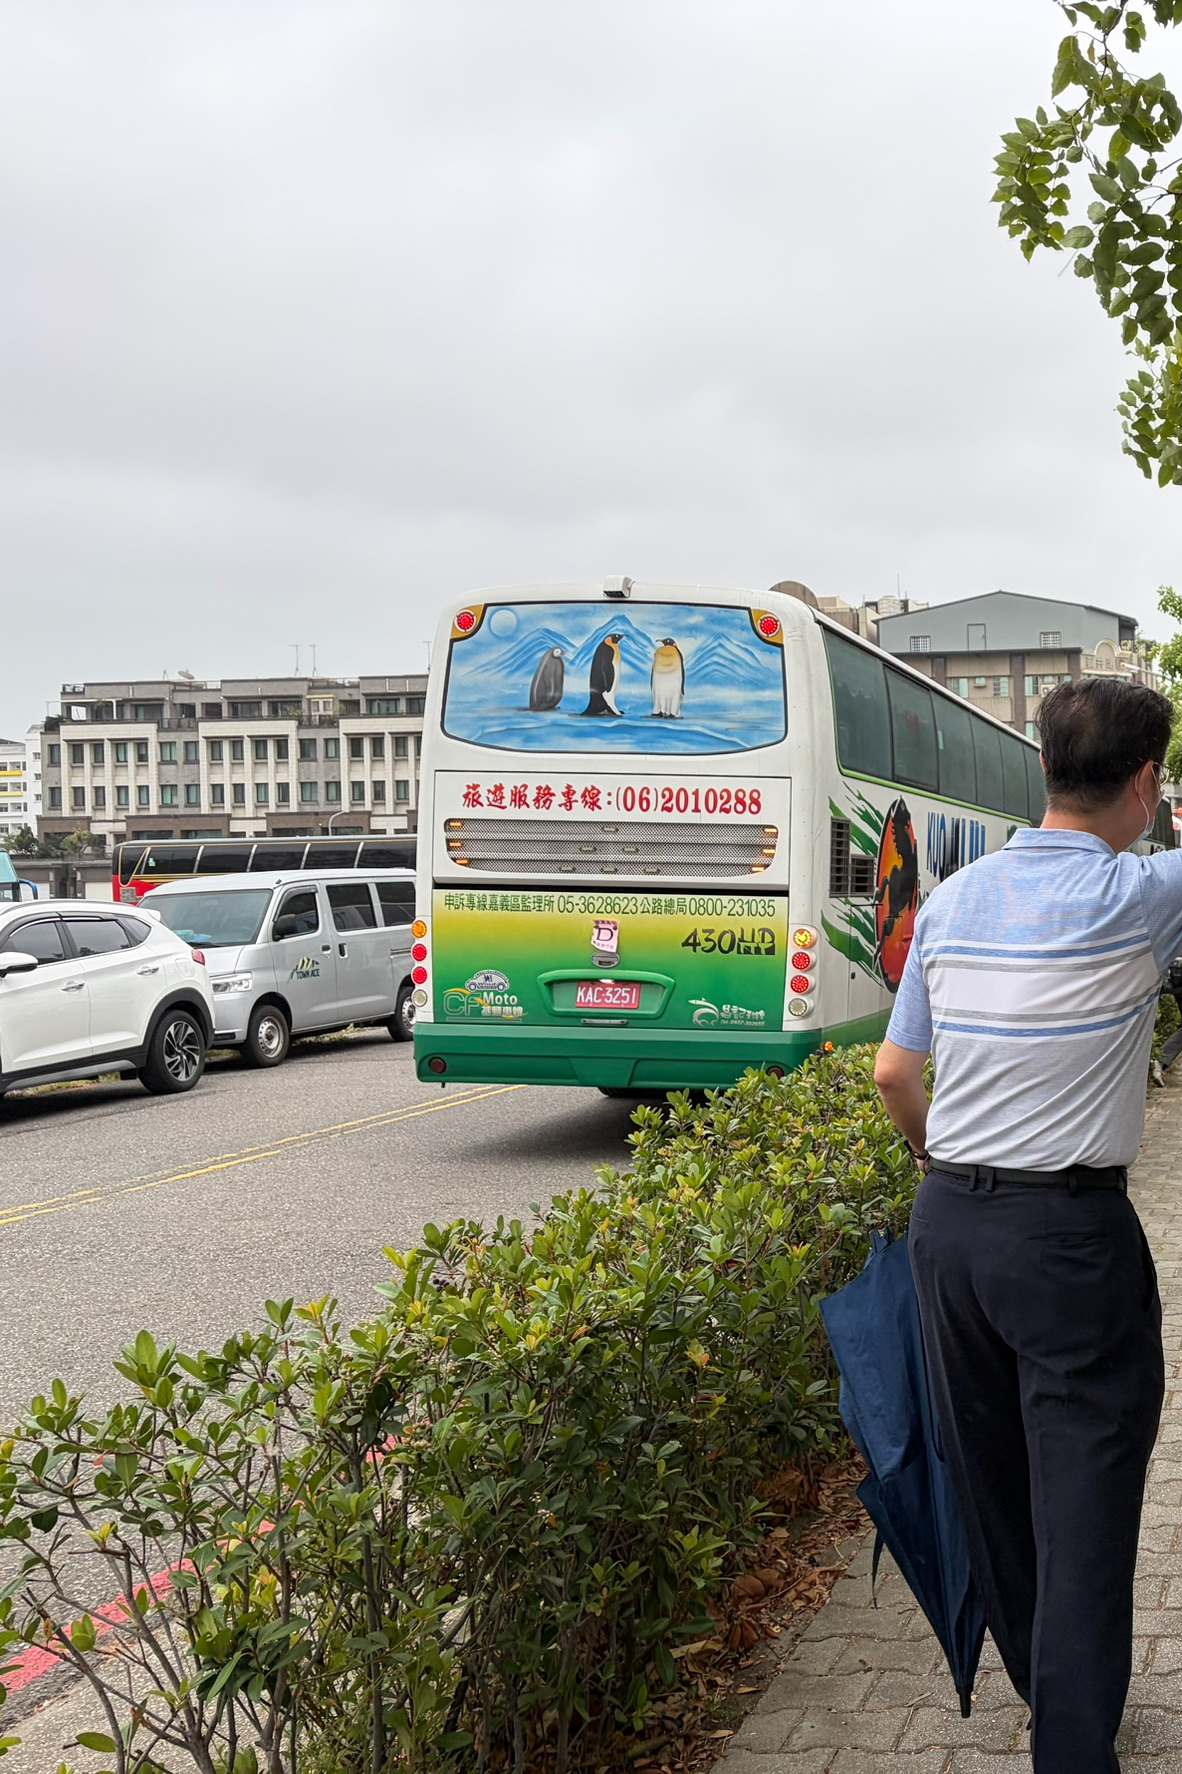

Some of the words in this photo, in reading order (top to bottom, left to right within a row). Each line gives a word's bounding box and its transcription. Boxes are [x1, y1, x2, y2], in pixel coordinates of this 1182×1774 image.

[558, 895, 638, 915] 05-3628623
[689, 897, 776, 918] 0800-231035
[482, 991, 518, 1006] Moto
